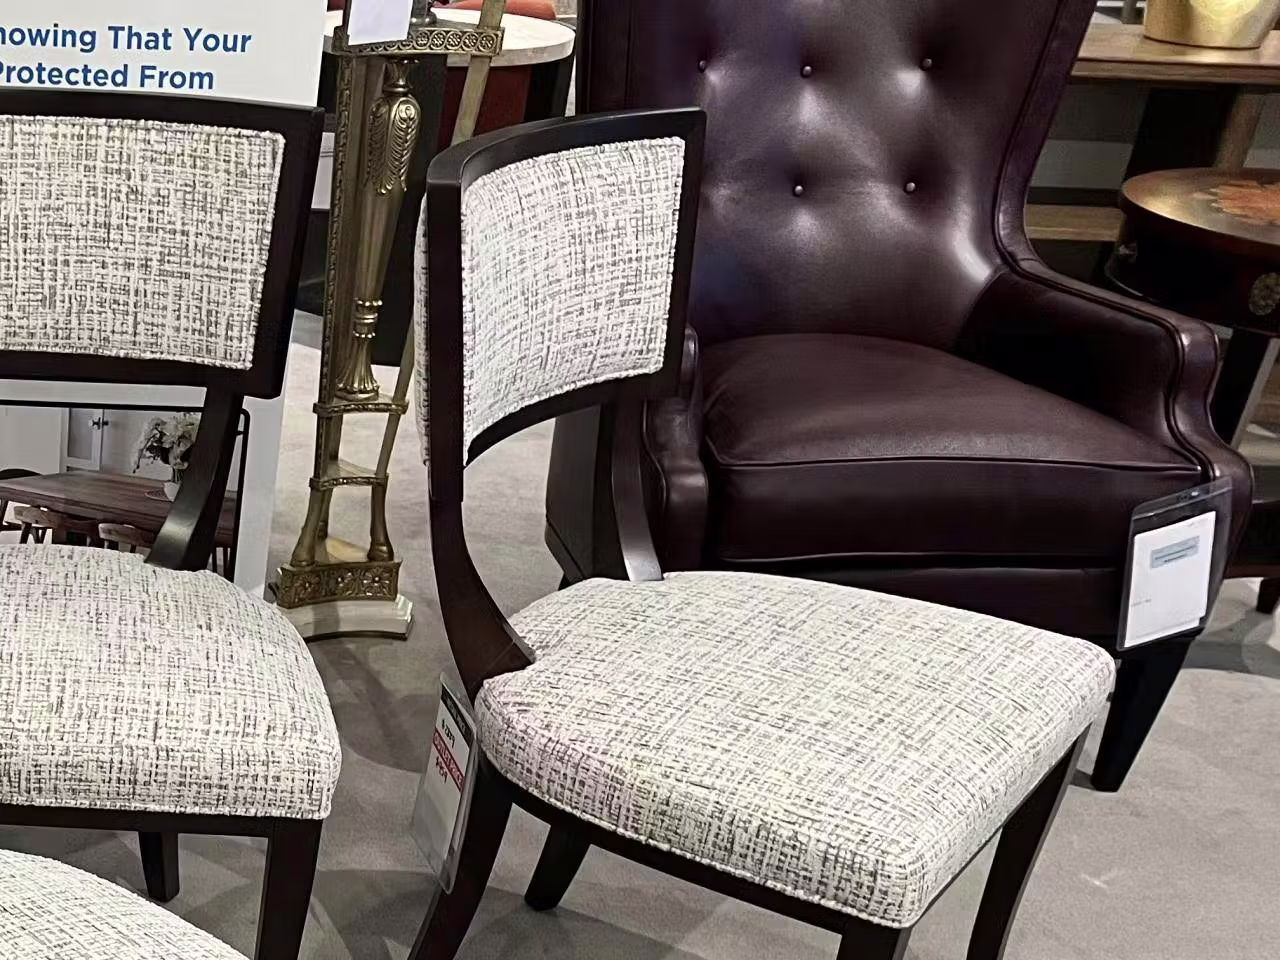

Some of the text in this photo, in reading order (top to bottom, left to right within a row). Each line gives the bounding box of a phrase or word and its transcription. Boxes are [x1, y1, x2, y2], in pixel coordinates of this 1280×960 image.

[108, 25, 172, 50] That
[183, 28, 252, 53] Your
[140, 65, 214, 90] From
